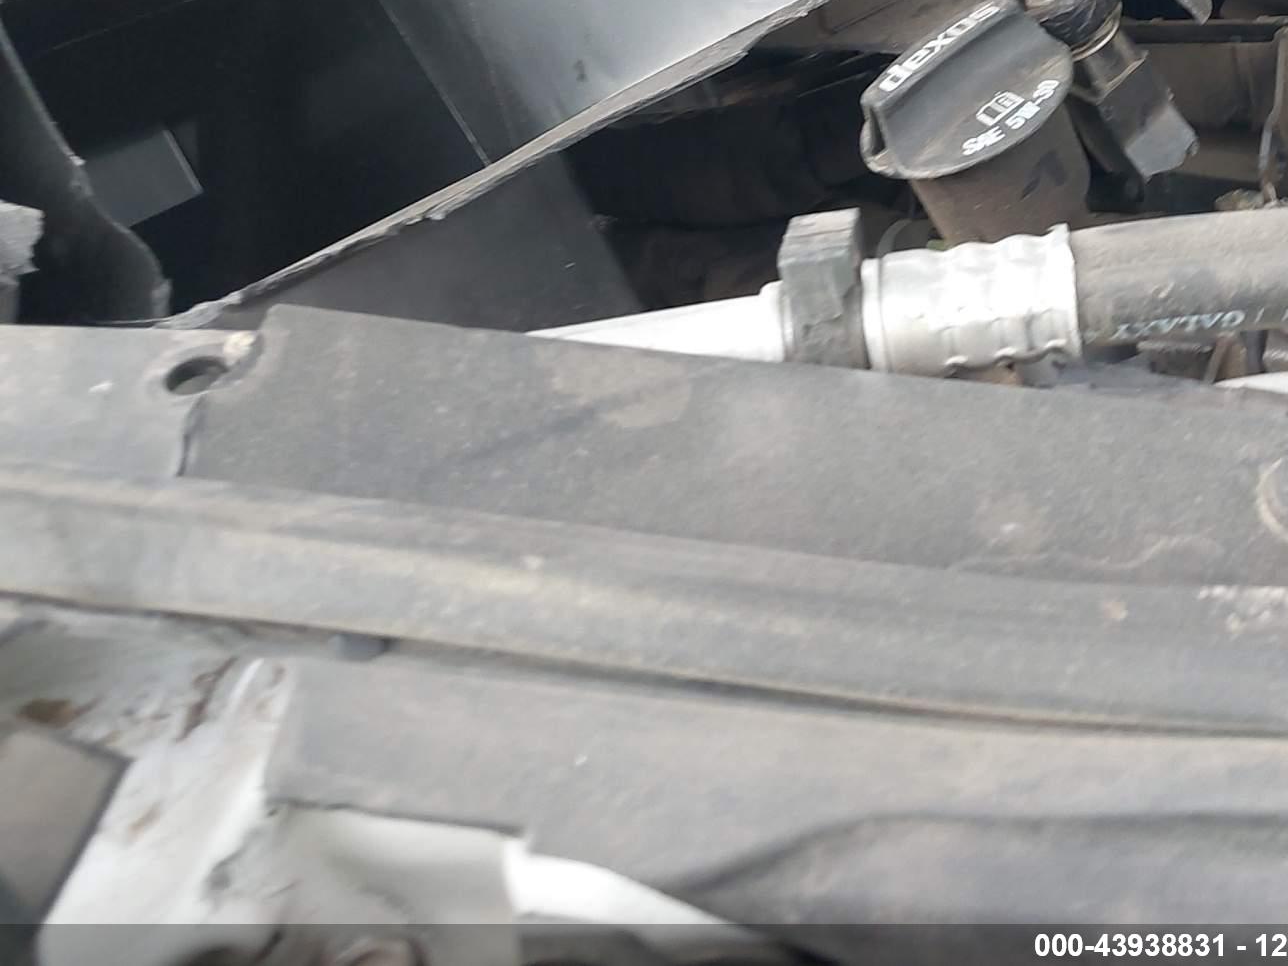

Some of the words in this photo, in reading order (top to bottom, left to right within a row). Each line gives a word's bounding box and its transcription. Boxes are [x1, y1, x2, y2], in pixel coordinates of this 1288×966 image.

[878, 1, 1001, 93] dexos
[961, 125, 1006, 157] SAE
[1006, 79, 1060, 130] 5W-30
